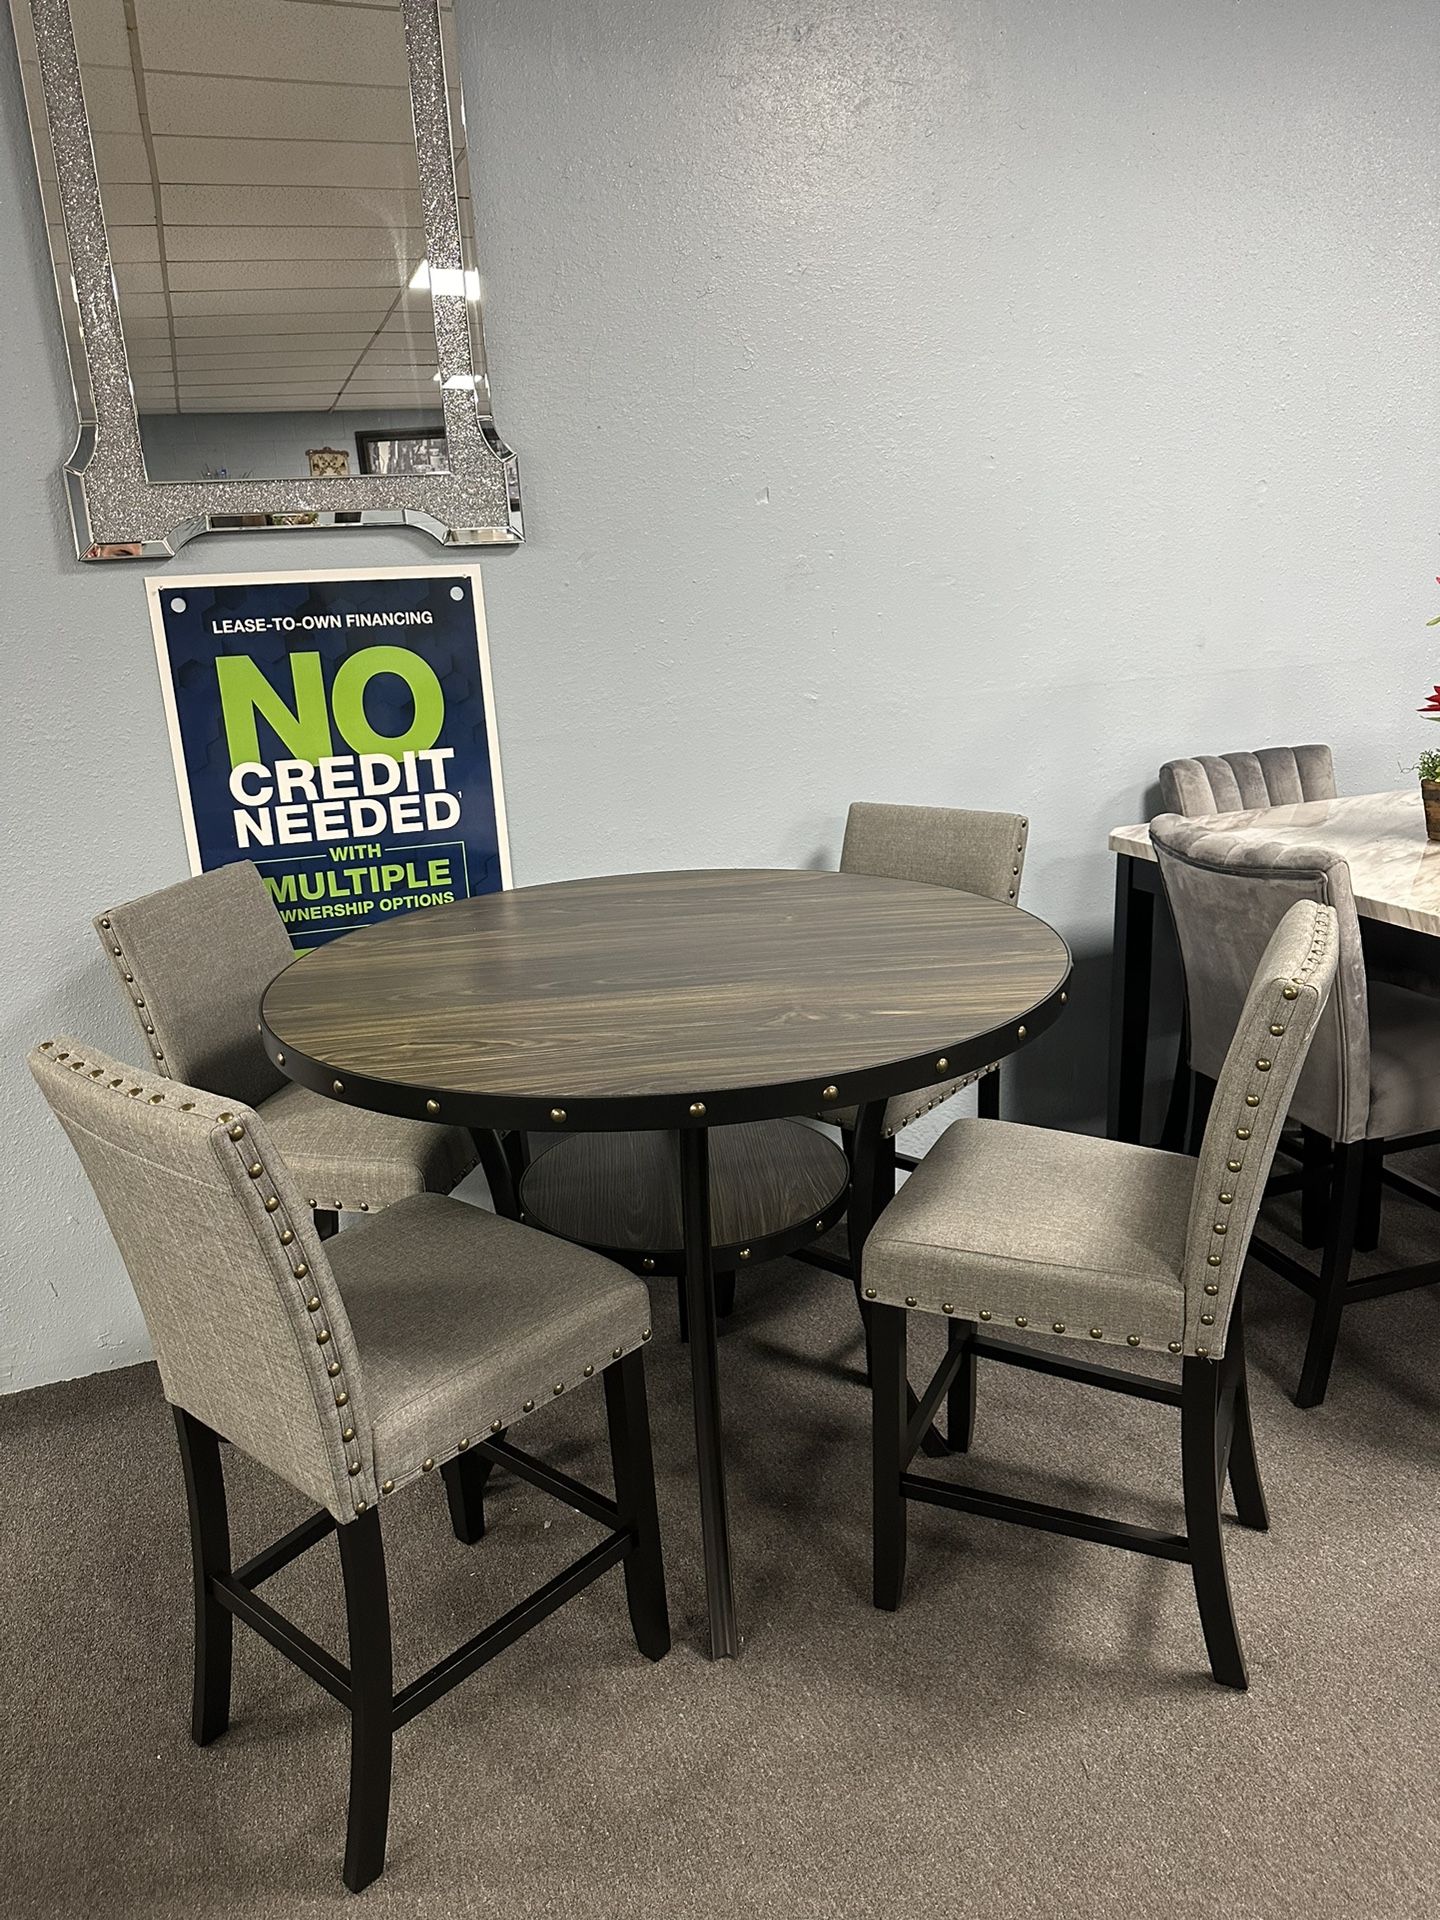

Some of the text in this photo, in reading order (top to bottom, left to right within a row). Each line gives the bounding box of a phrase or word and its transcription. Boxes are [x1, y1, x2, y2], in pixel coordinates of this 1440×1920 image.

[212, 611, 433, 634] LEASE-TO-OWN FINANCING
[215, 645, 445, 770] NO
[228, 747, 455, 807] CREDIT
[329, 843, 382, 862] WITH
[263, 858, 452, 903] MULTIPLE
[280, 891, 455, 923] WNERSHIP OPTIONS
